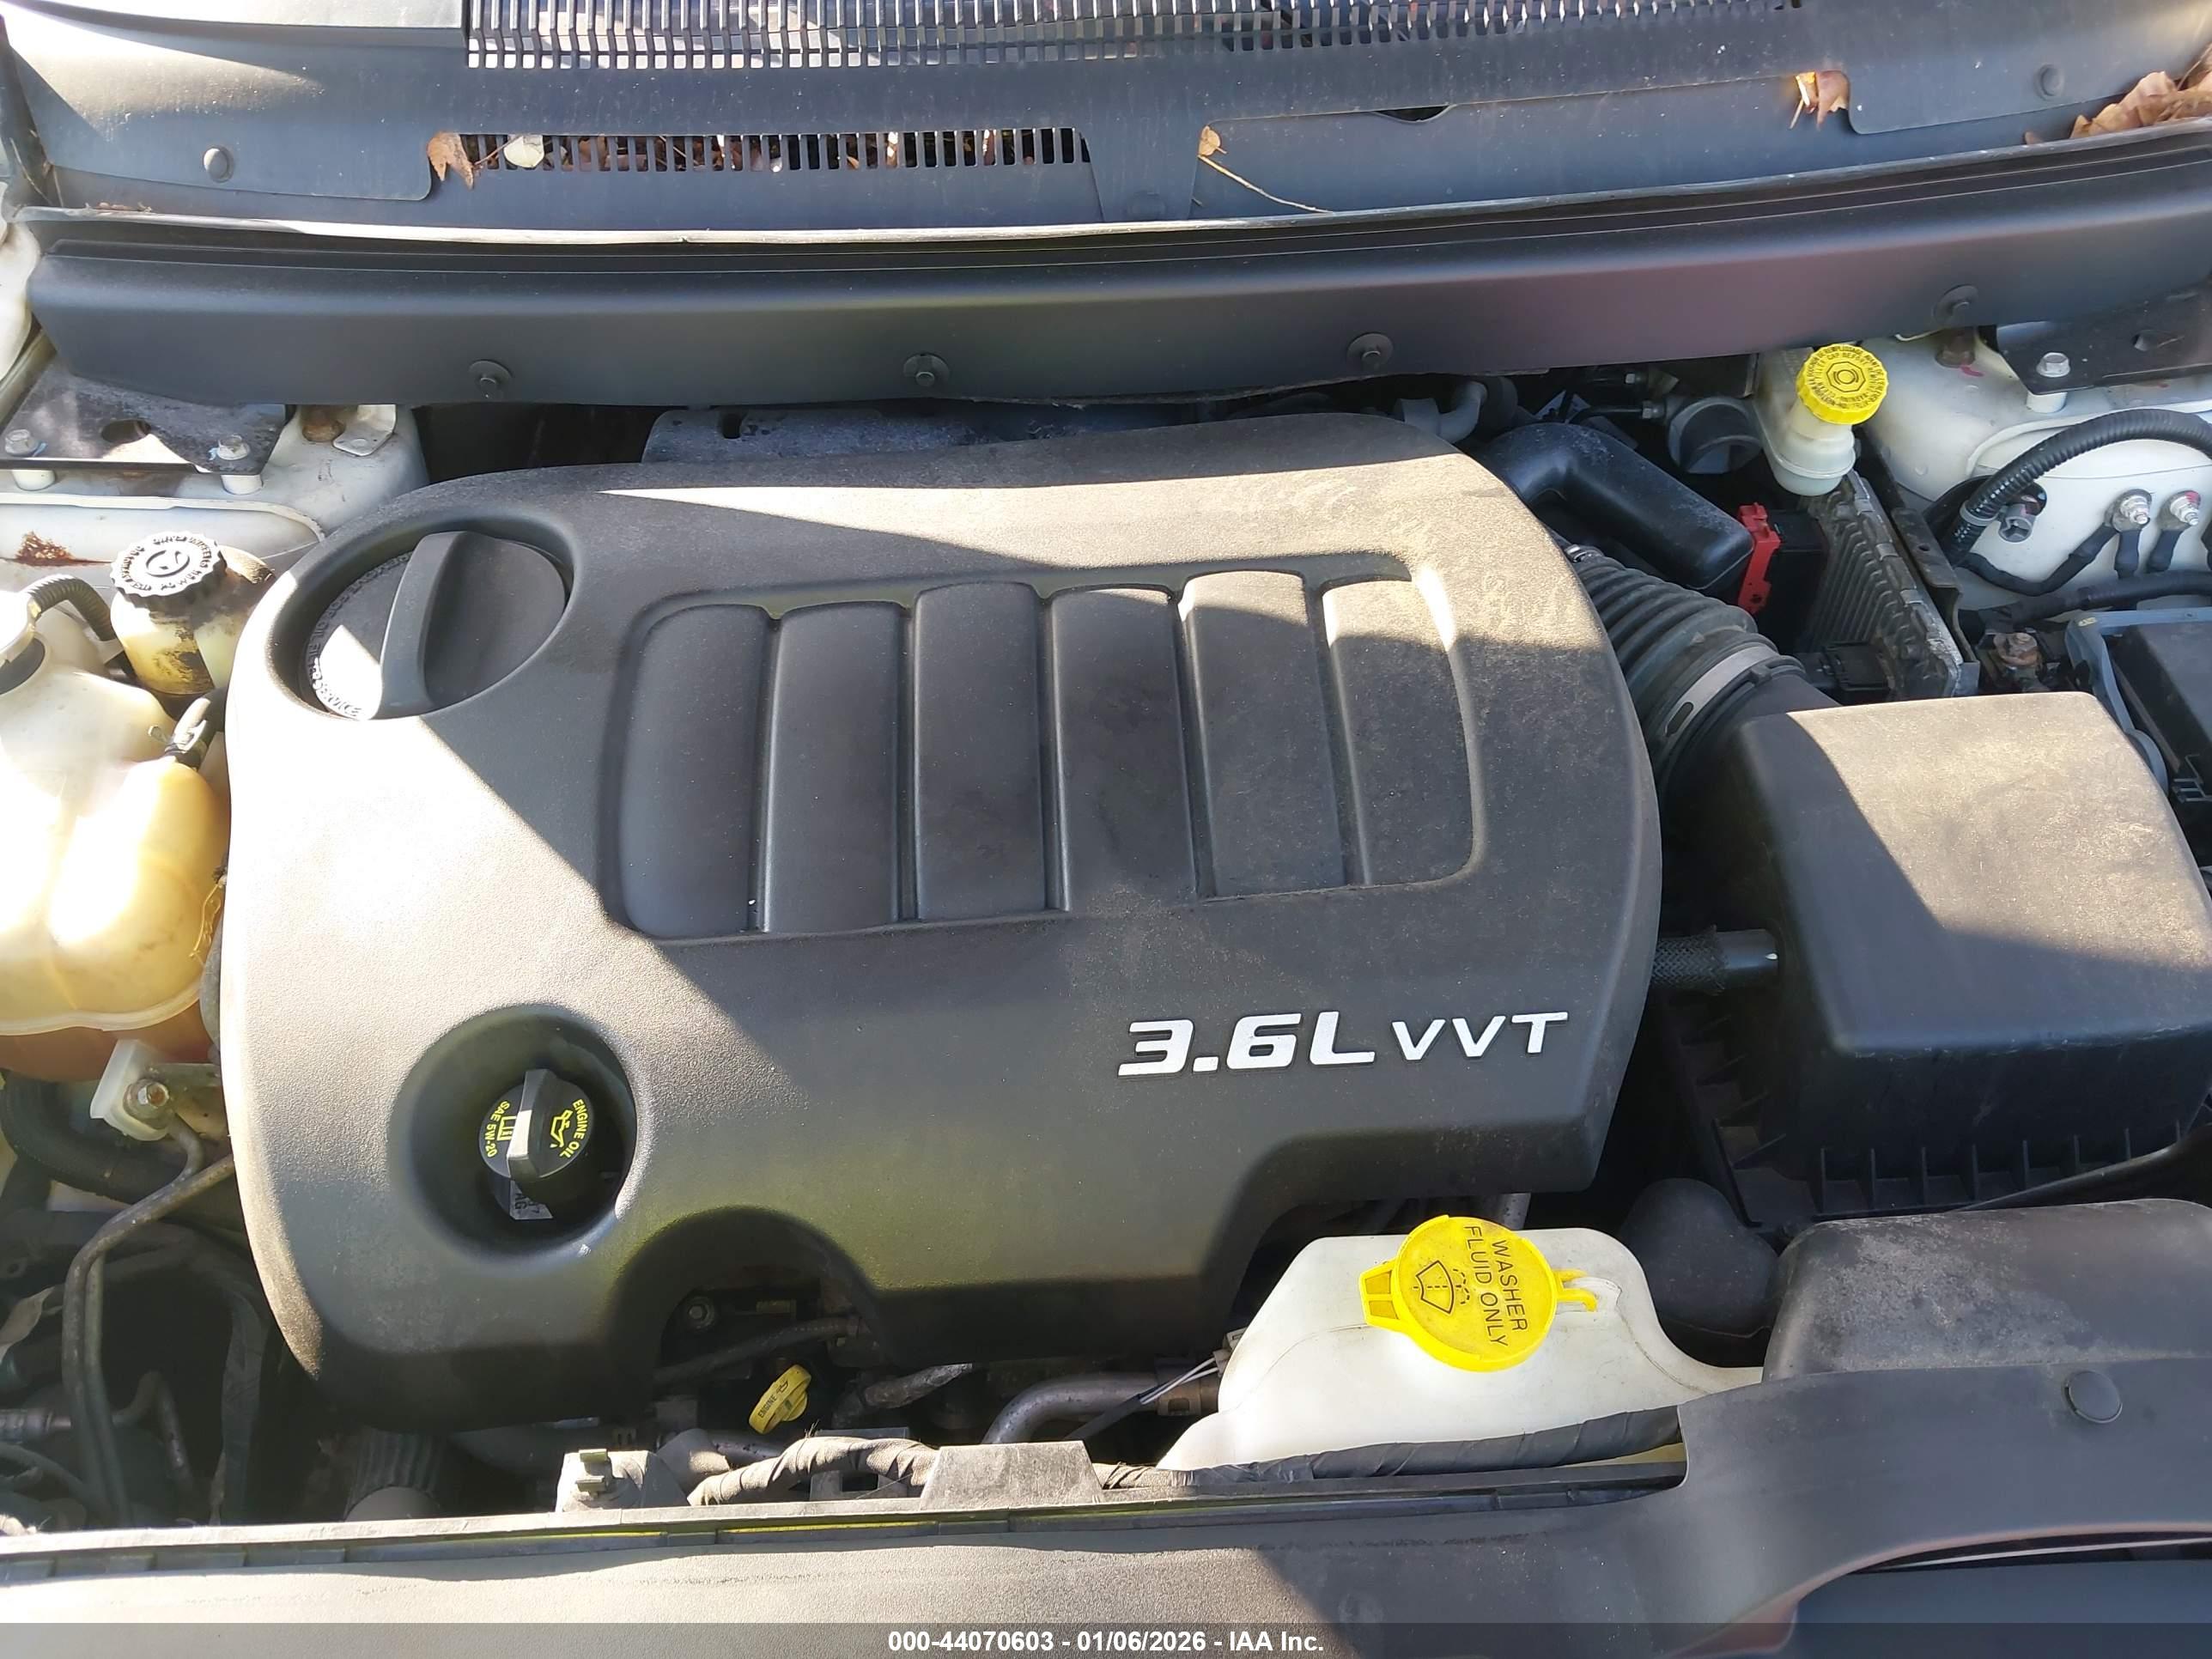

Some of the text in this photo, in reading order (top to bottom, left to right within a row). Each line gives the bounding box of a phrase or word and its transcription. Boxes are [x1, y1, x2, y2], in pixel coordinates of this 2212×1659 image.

[309, 622, 330, 644] OIL
[328, 593, 351, 619] FOR
[1117, 1011, 1570, 1077] 3.6L VVT
[484, 1101, 510, 1158] SAE 5W-20
[559, 1098, 588, 1158] ENGINE OIL
[1463, 1225, 1509, 1346] FLUID ONLY
[1492, 1239, 1528, 1332] WASHER
[757, 1395, 777, 1419] ENGINE
